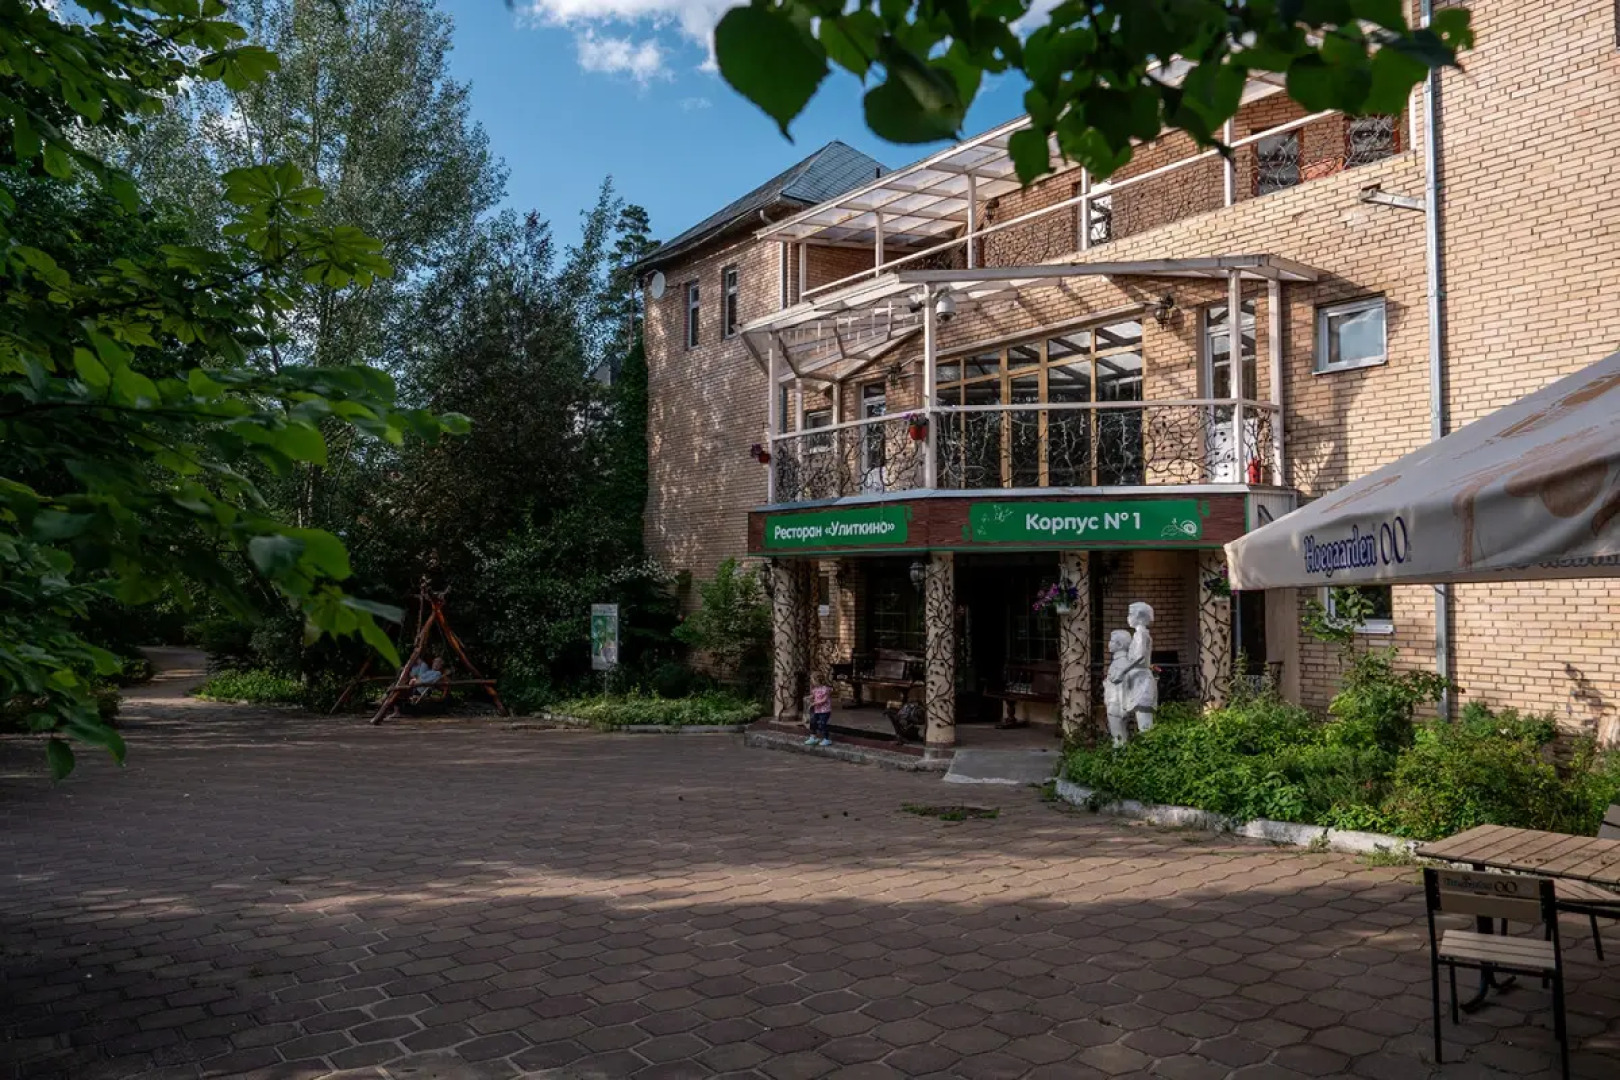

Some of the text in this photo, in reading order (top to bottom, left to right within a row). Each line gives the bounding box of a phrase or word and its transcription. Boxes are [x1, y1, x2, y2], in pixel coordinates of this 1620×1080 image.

[774, 521, 895, 542] Ресторан «Улиткино»
[1026, 513, 1099, 535] Корпус
[1304, 524, 1377, 578] Hoegaarden
